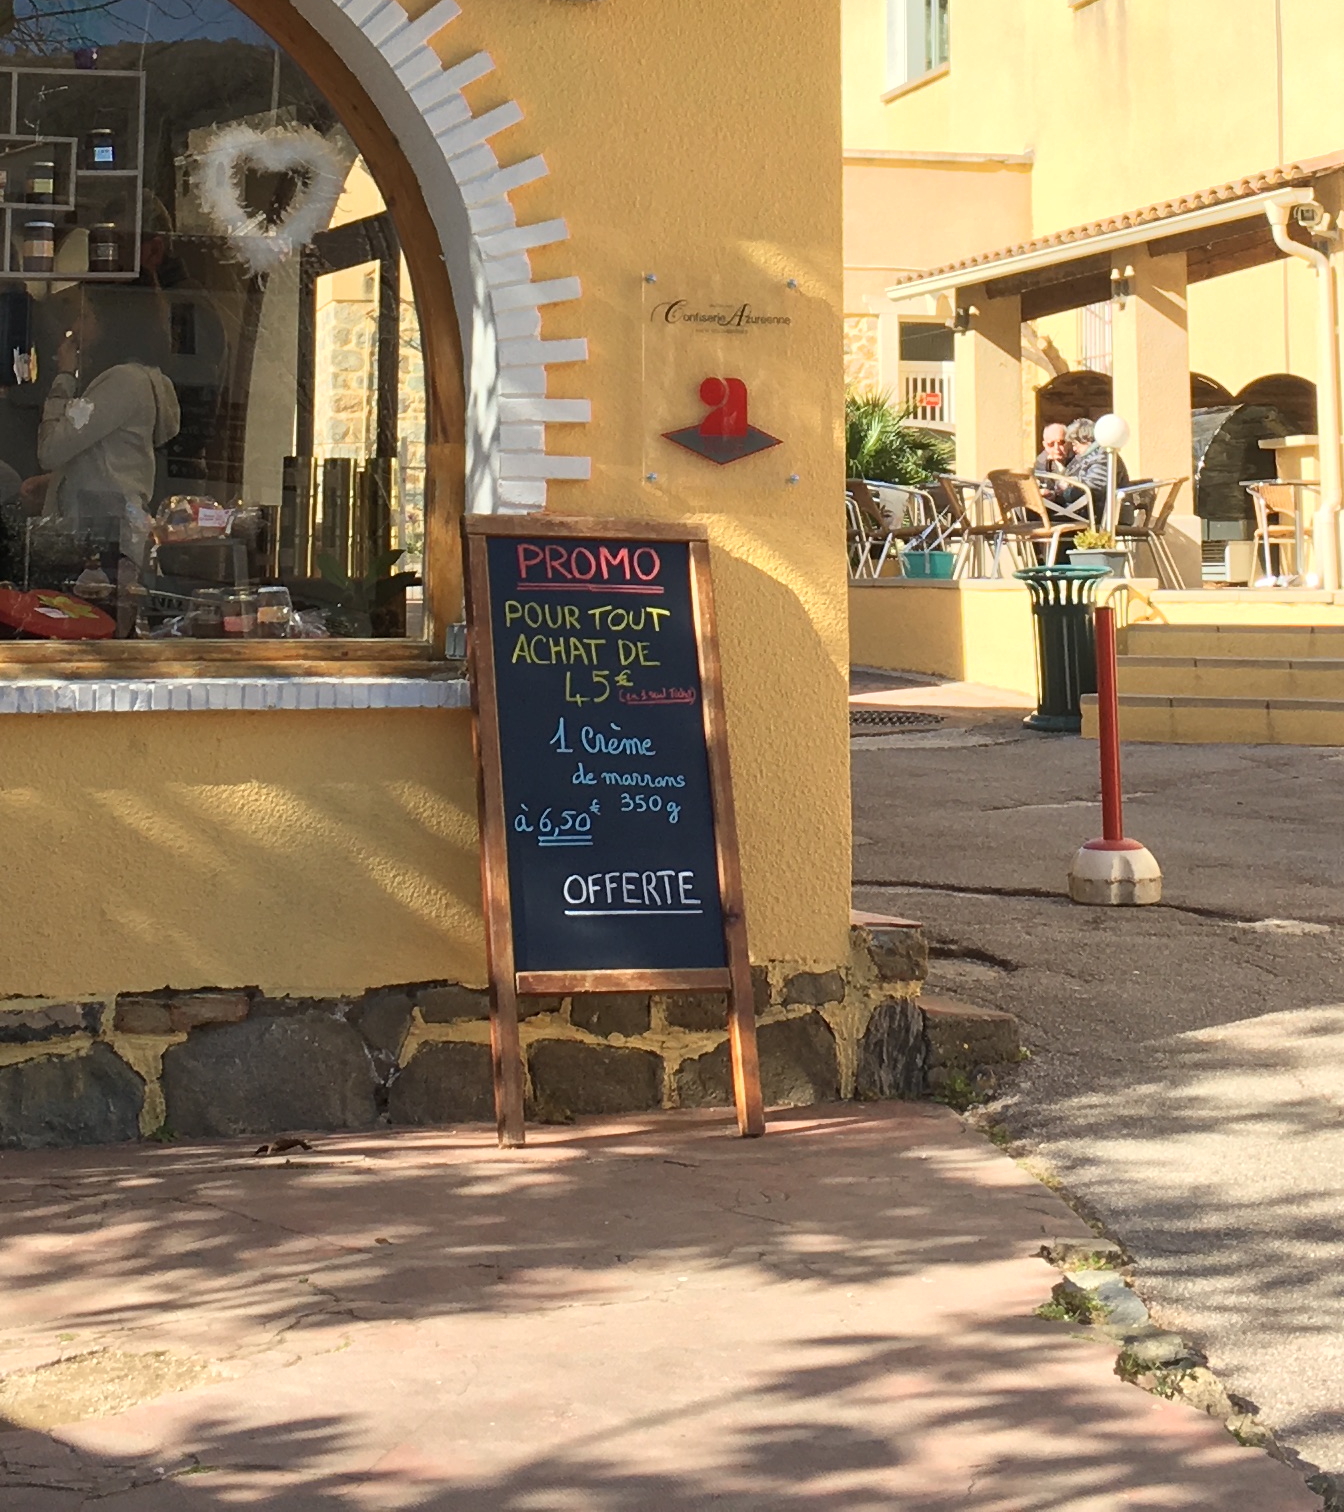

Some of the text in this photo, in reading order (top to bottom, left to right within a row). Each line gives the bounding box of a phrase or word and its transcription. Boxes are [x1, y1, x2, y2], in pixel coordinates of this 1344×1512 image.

[516, 543, 661, 581] PROMO
[505, 600, 671, 632] POUR TOUT
[511, 634, 661, 666] ACHAT DE
[549, 717, 656, 756] 1 Crème
[572, 762, 686, 788] de marrons
[514, 803, 535, 832] à
[563, 870, 702, 906] OFFERTE
